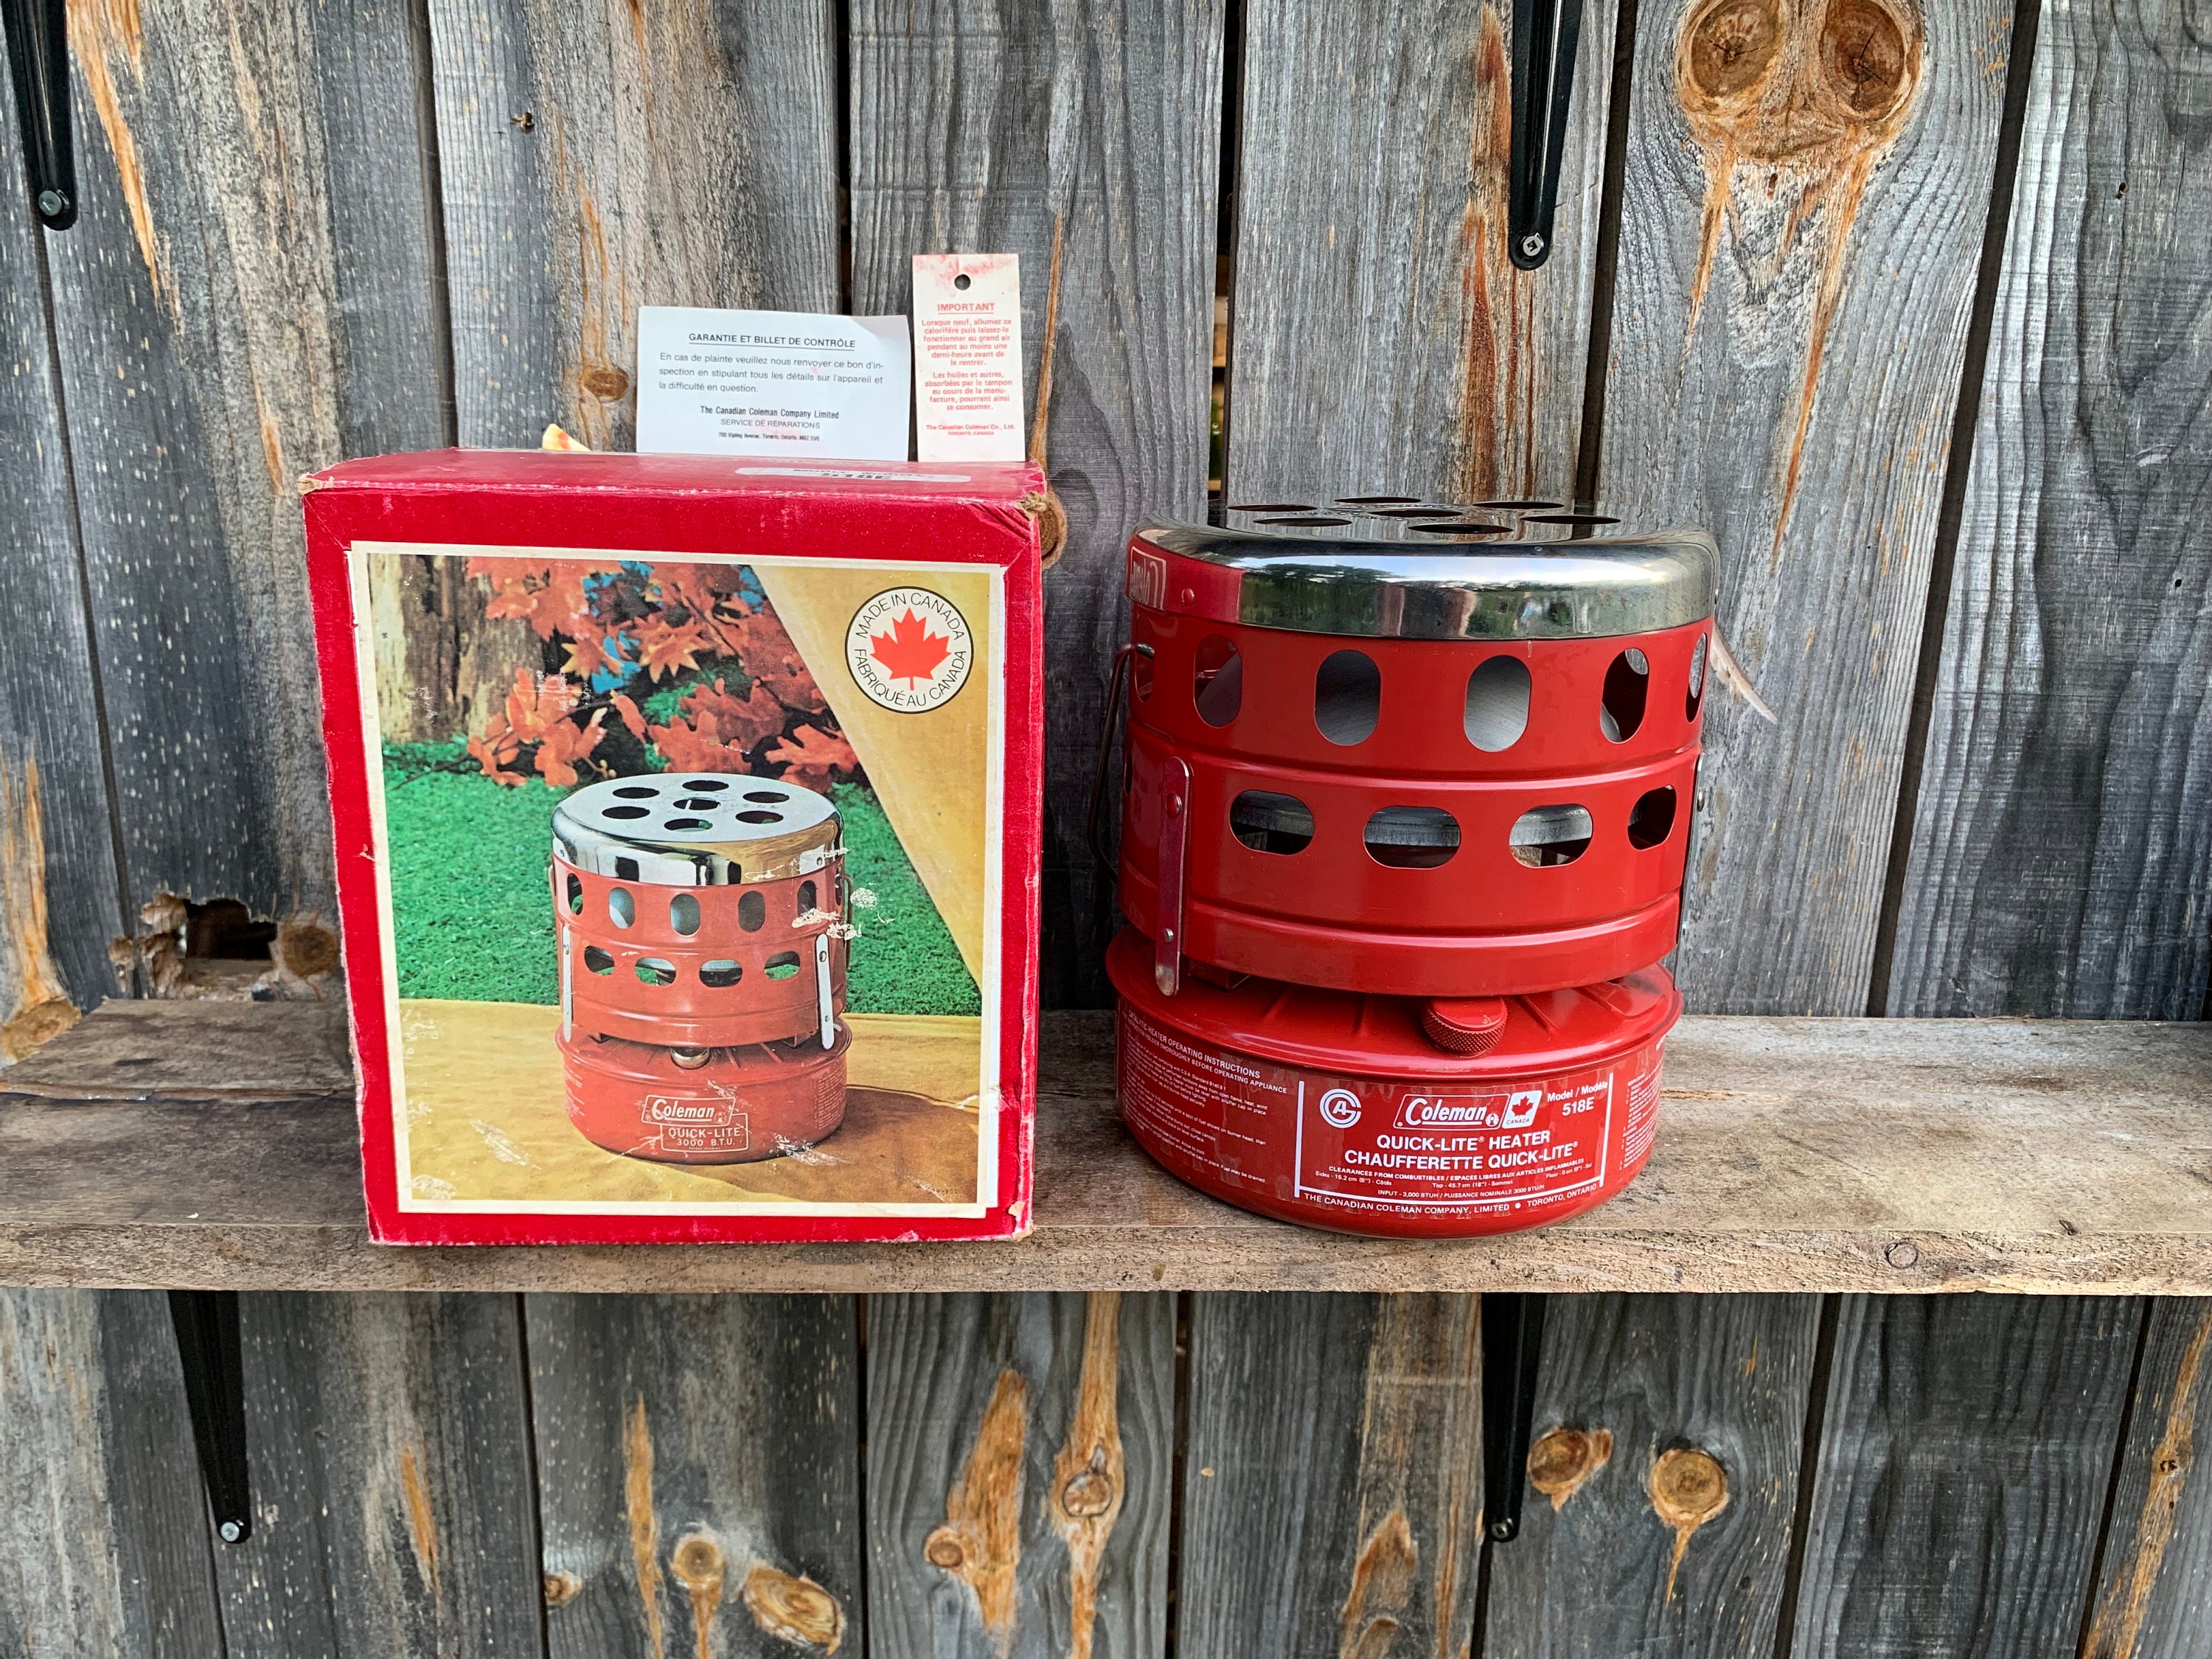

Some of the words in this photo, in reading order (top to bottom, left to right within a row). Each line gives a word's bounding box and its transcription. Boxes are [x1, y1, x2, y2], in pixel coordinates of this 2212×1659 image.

[937, 303, 995, 311] IMPORTANT
[689, 333, 737, 342] GARANTIE
[754, 335, 786, 344] BILLET
[804, 338, 855, 347] CONTRÔLE
[978, 335, 999, 343] grand
[927, 343, 957, 351] pendant
[705, 355, 733, 363] plainte
[735, 355, 768, 364] veuillez
[866, 361, 884, 369] d'in-
[659, 368, 695, 376] spection
[712, 369, 747, 378] stipulant
[787, 372, 814, 380] détails
[833, 374, 872, 383] l'appareil
[659, 381, 666, 389] la
[668, 382, 705, 391] difficulté
[720, 384, 758, 393] question.
[700, 406, 713, 414] The
[715, 406, 746, 415] Canadian
[749, 408, 778, 416] Coleman
[781, 408, 811, 418] Company
[814, 410, 839, 419] Limited
[720, 418, 753, 426] SERVICE
[856, 598, 891, 638] MADE
[891, 593, 907, 607] IN
[911, 592, 964, 640] CANADA
[855, 649, 906, 706] FABRIQUÉ
[907, 694, 927, 706] AU
[929, 650, 967, 700] CANADA
[1148, 1026, 1167, 1043] HEATER
[1168, 1037, 1203, 1060] OPERATING
[1204, 1054, 1261, 1079] INSTRUCTIONS
[1160, 1043, 1191, 1063] THOROUGHLY
[1192, 1059, 1213, 1072] BEFORE
[1214, 1068, 1248, 1084] OPERATING
[1250, 1079, 1287, 1094] APPLIANCE
[1547, 1089, 1573, 1102] Model
[1581, 1081, 1608, 1095] Modèle
[652, 1099, 715, 1120] Coleman
[1405, 1098, 1486, 1125] Coleman
[1562, 1096, 1595, 1116] 518E
[668, 1127, 741, 1138] QUICK-LITE
[1489, 1130, 1551, 1150] HEATER
[676, 1138, 703, 1147] 3000
[711, 1138, 735, 1147] B.T.U.
[1344, 1150, 1483, 1170] CHAUFFERETTE
[1315, 1170, 1330, 1178] Sides
[1329, 1166, 1373, 1177] CLEARANCES
[1394, 1173, 1445, 1181] COMBUSTIBLES
[1516, 1167, 1544, 1177] ARTICLES
[1545, 1158, 1585, 1172] INFLAMMABLES
[1304, 1192, 1322, 1203] THE
[1324, 1197, 1374, 1210] CANADIAN
[1376, 1204, 1422, 1214] COLEMAN
[1424, 1207, 1472, 1215] COMPANY,
[1474, 1204, 1510, 1214] LIMITED
[1527, 1194, 1565, 1207] TORONTO,
[1566, 1183, 1597, 1199] ONTARIO
[1480, 1189, 1512, 1197] NOMINALE
